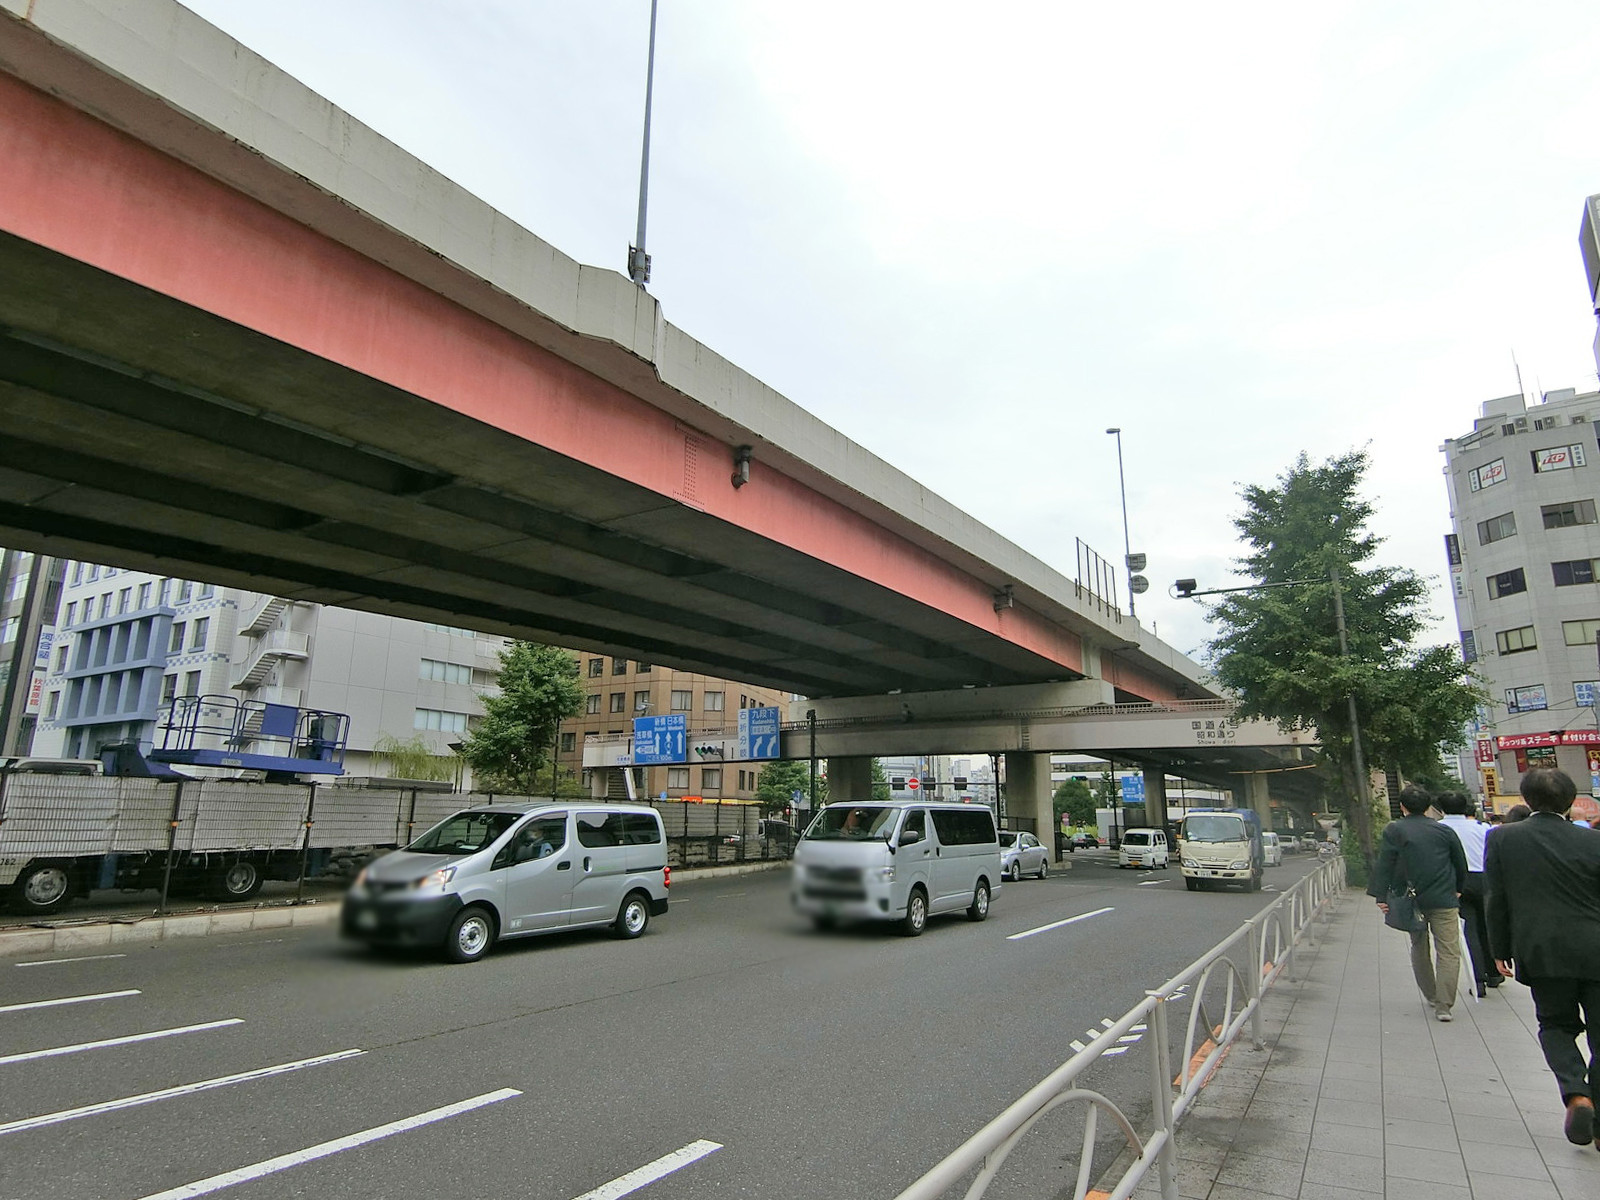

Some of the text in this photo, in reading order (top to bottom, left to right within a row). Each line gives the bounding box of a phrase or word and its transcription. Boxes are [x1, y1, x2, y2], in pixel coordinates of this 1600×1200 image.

[37, 632, 54, 659] 河合塾
[752, 709, 775, 719] 九段下
[667, 715, 684, 725] 日本橋
[739, 711, 747, 758] 右折分岐
[1196, 730, 1236, 739] 昭和通り
